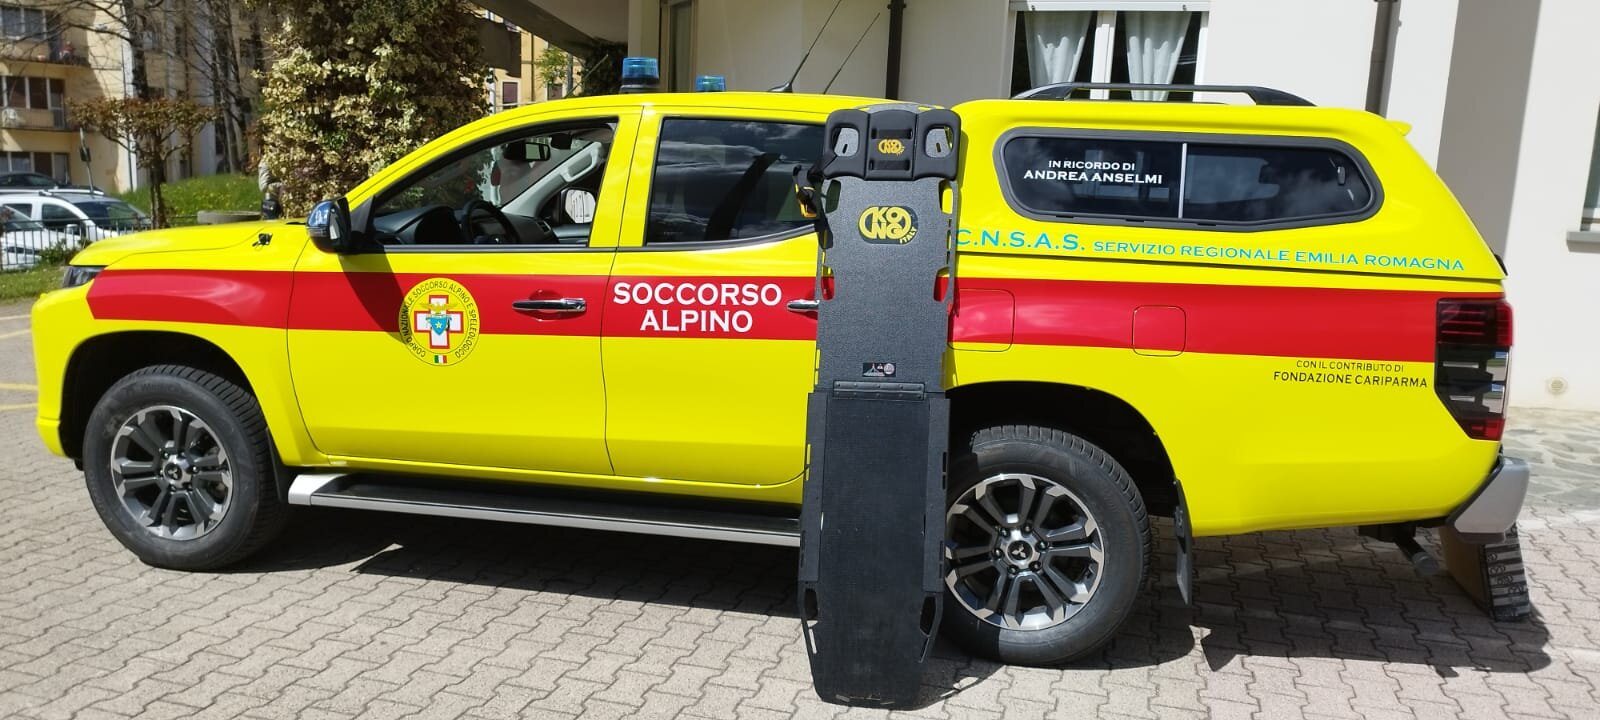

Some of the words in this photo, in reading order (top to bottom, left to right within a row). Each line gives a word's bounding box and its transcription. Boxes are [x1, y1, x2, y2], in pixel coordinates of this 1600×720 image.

[1048, 160, 1061, 168] IN
[1063, 160, 1120, 171] RICORDO
[1122, 162, 1135, 171] DI
[1023, 169, 1088, 181] ANDREA
[1091, 172, 1162, 184] ANSELMI
[900, 226, 918, 243] ITALY
[956, 229, 1085, 251] C.N.S.A.S.
[1094, 241, 1175, 255] SERVIZIO
[1180, 245, 1289, 261] REGIONALE
[1296, 251, 1359, 265] EMILIA
[1364, 254, 1465, 271] ROMAGNA
[412, 280, 448, 298] SOCCORSO
[448, 283, 470, 303] ALPINO
[613, 282, 782, 306] SOCCORSO
[400, 295, 414, 337] NAZIONALE
[640, 309, 753, 333] ALPINO
[454, 309, 478, 359] SPELEOLOGICO
[406, 337, 426, 358] CORPO
[1296, 360, 1316, 369] CON
[1318, 361, 1327, 369] IL
[1329, 361, 1392, 372] CONTRIBUTO
[1394, 364, 1404, 372] DI
[1273, 371, 1352, 384] FONDAZIONE
[1355, 375, 1428, 388] CARIPARMA
